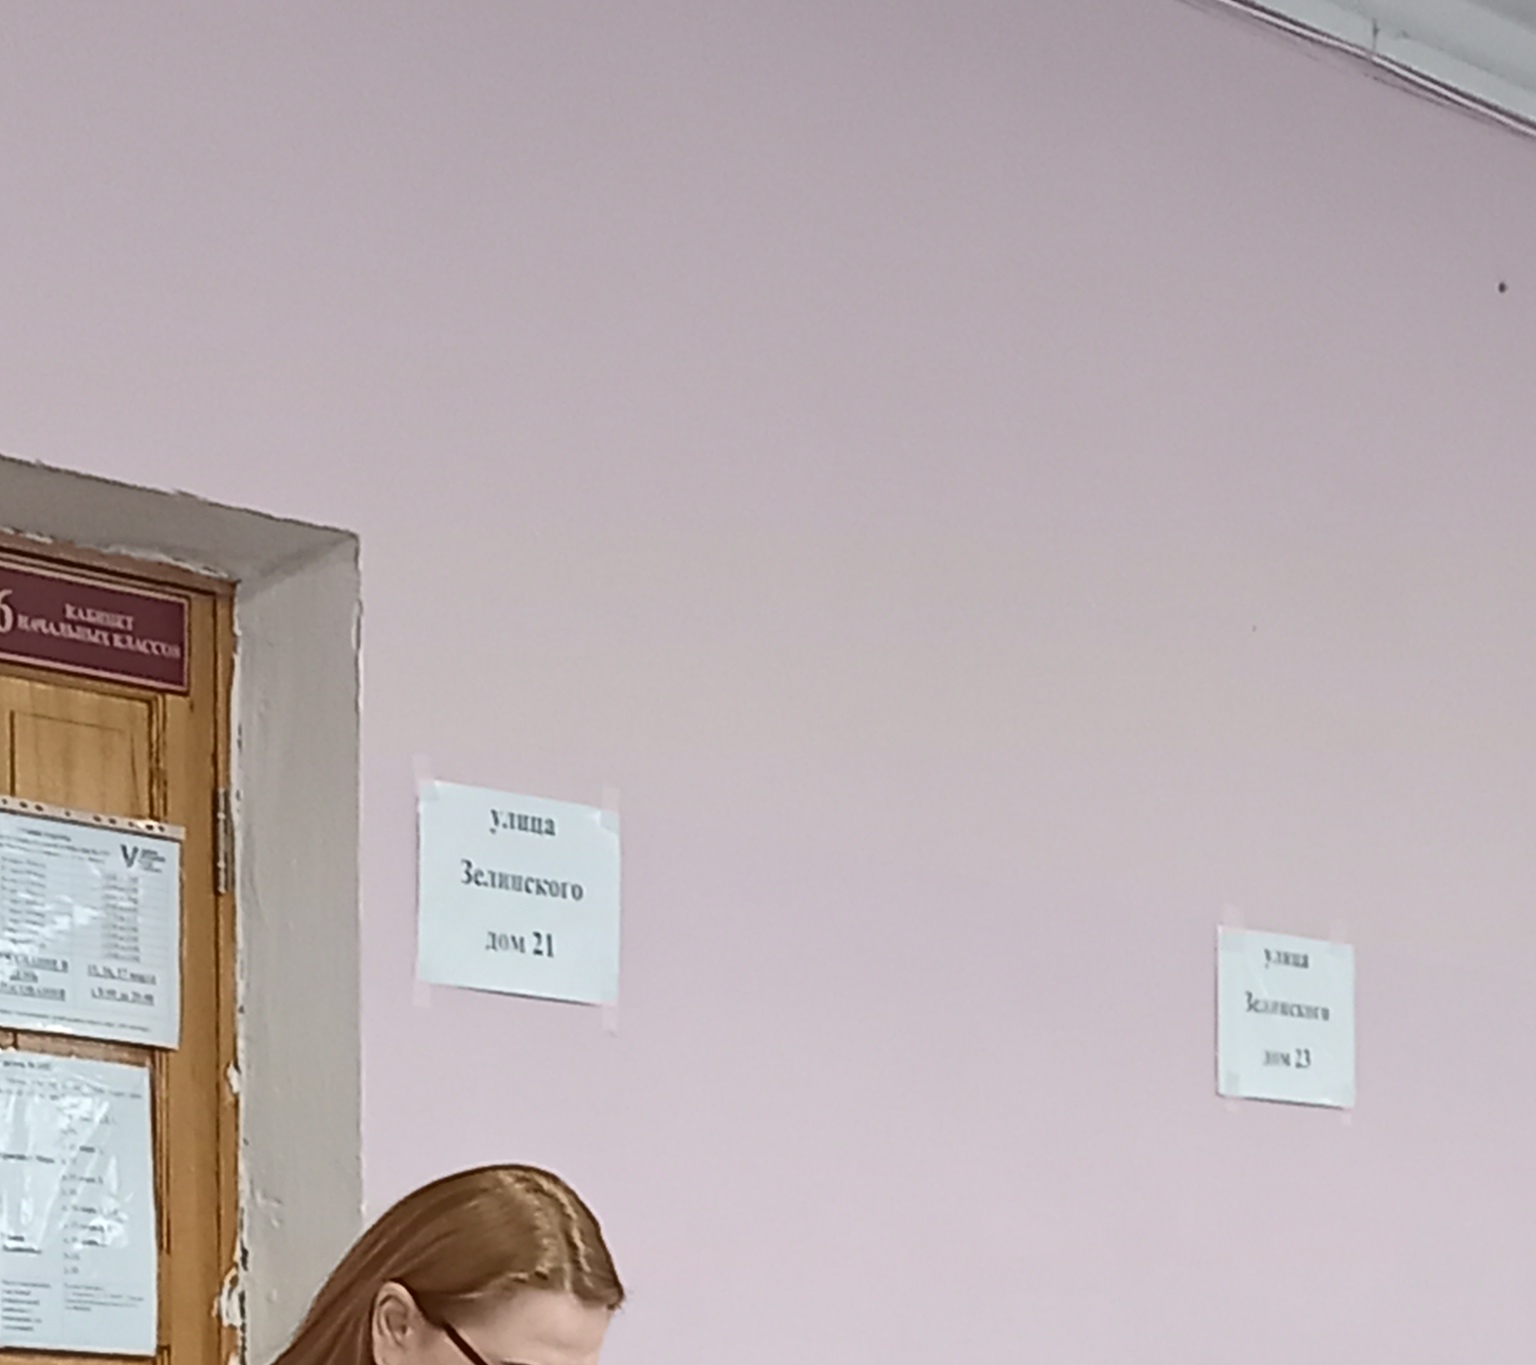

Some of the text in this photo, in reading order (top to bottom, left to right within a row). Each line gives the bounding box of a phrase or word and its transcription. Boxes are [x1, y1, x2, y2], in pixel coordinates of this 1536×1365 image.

[490, 809, 556, 836] улица
[461, 859, 584, 901] Зелинского
[486, 931, 554, 958] дом 21
[1263, 1048, 1312, 1068] дом 23
